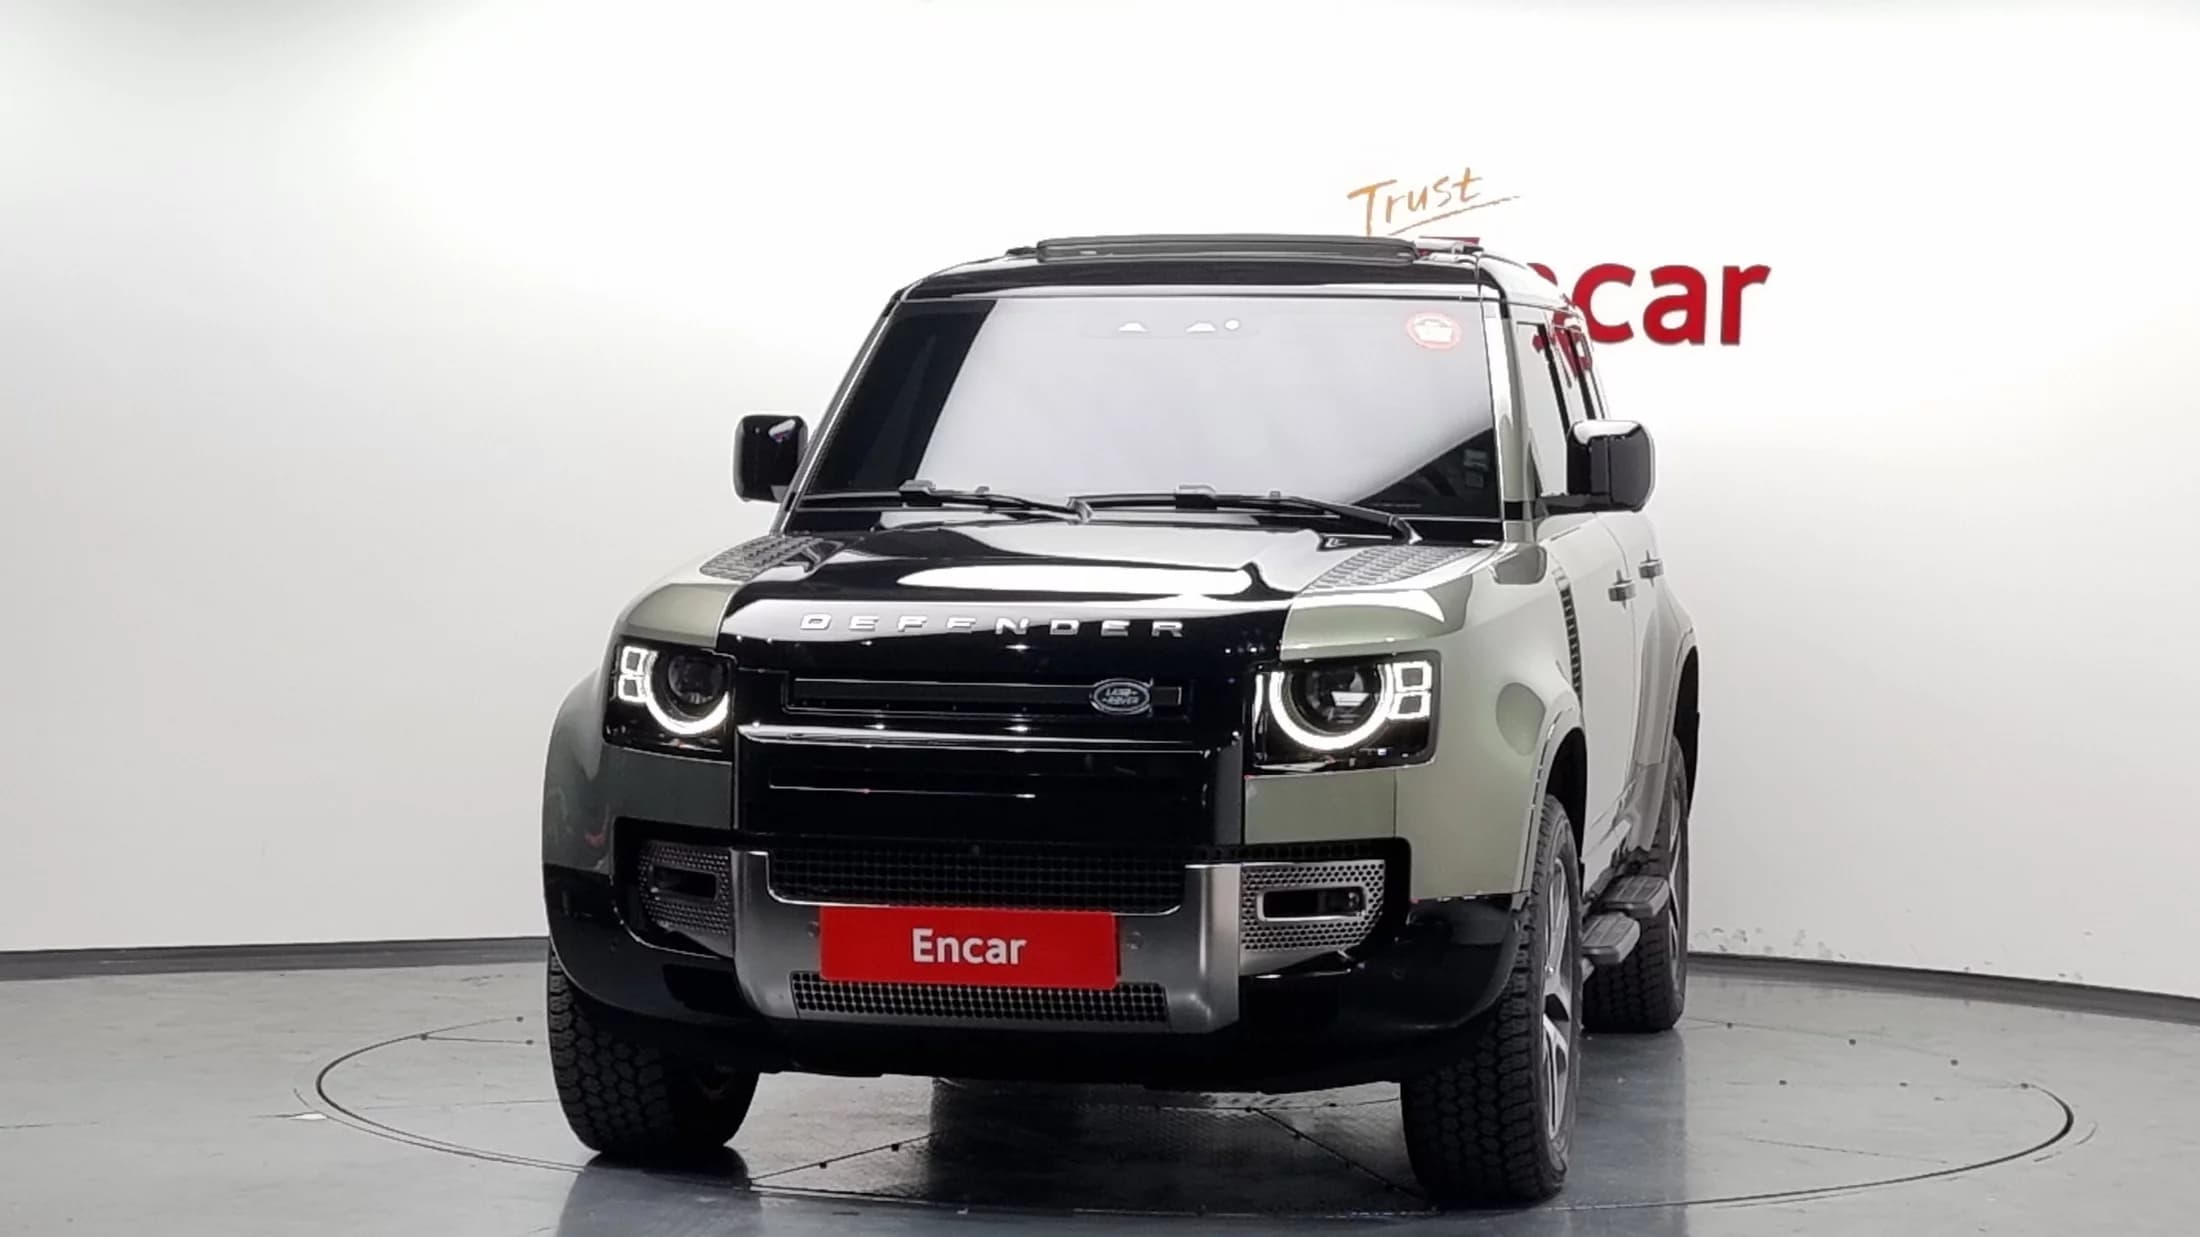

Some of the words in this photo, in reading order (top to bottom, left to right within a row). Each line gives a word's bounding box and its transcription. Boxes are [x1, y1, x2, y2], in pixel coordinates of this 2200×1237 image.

[1347, 167, 1483, 237] Trust
[1524, 261, 1772, 346] car
[799, 613, 1185, 637] DEFENDER
[912, 927, 1027, 965] Encar
